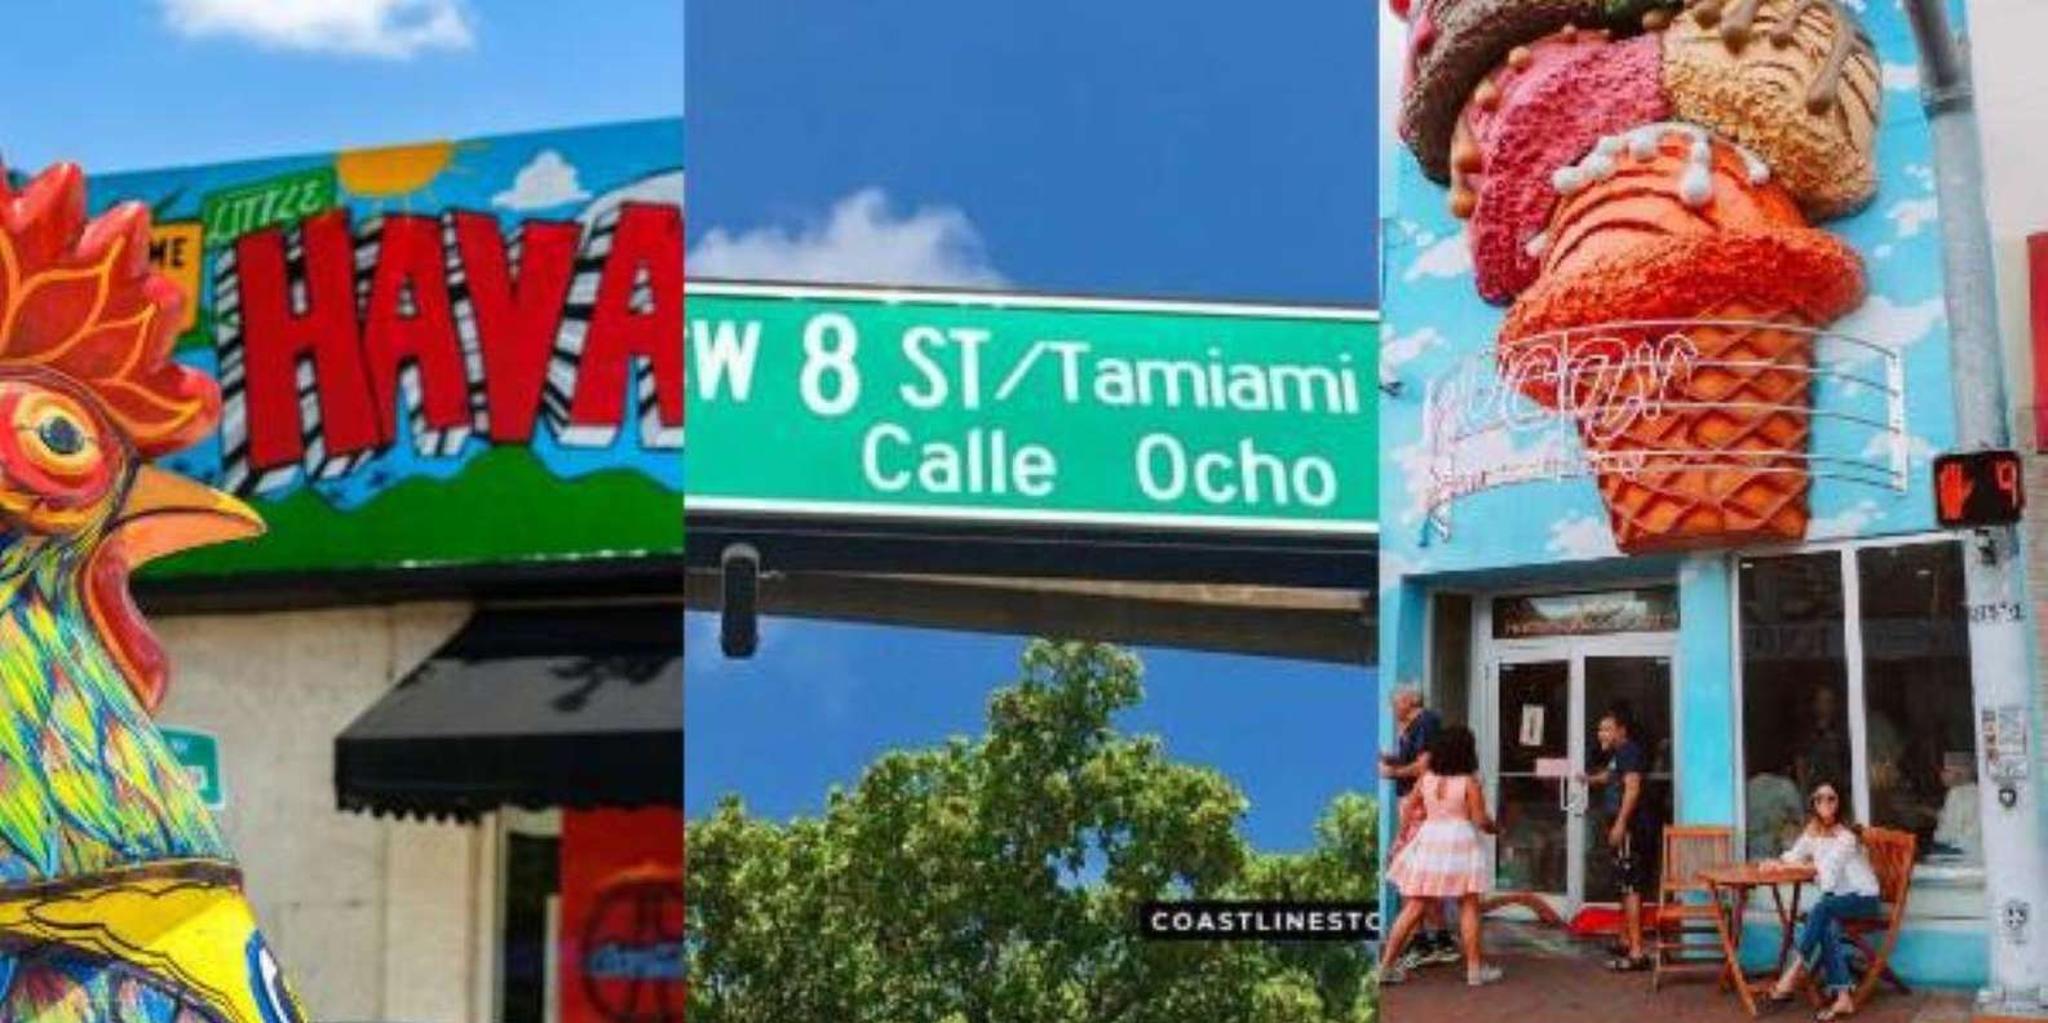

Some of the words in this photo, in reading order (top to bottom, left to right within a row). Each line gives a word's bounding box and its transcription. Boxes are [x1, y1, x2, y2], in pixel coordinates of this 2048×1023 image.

[205, 180, 321, 244] LITTLE
[222, 203, 683, 478] HAVA
[684, 319, 762, 401] W
[801, 312, 860, 416] 8
[862, 423, 1058, 495] Calle
[1135, 432, 1337, 507] Ocho
[1995, 459, 2017, 510] 9
